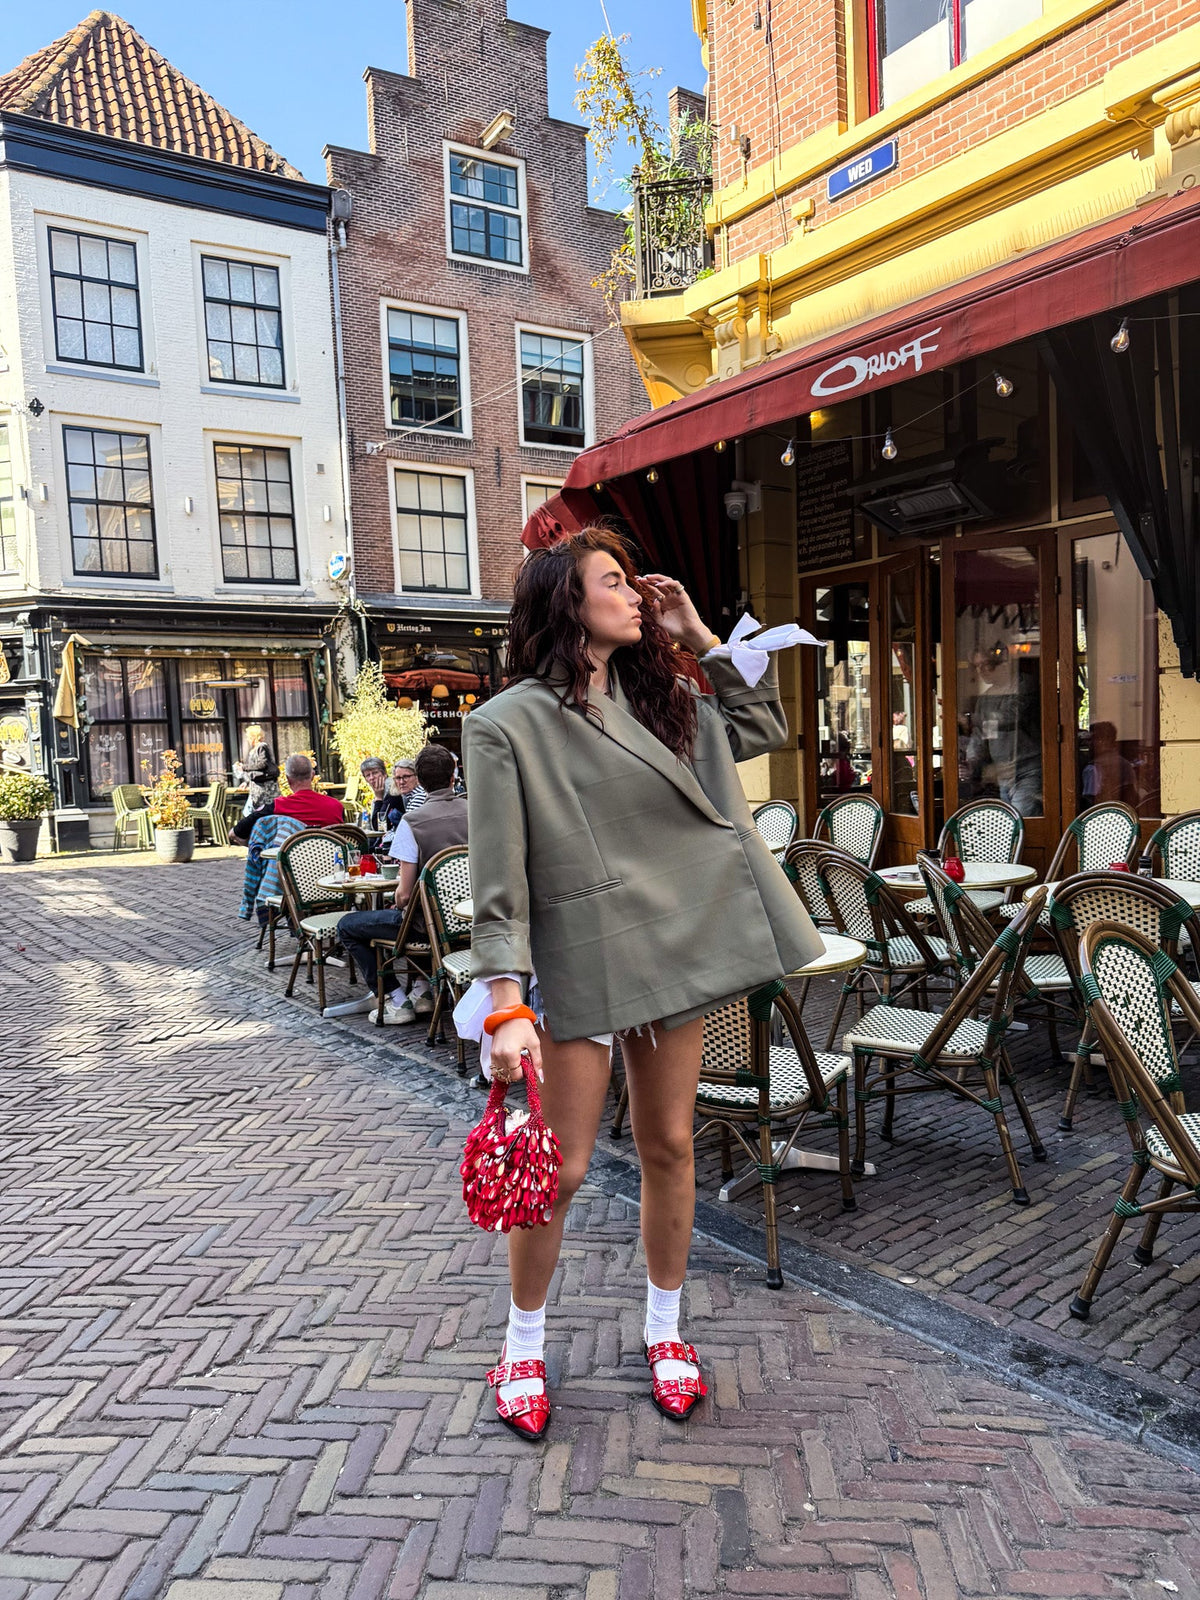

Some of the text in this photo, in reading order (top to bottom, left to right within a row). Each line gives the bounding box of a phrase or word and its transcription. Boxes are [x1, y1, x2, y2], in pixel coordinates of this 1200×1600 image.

[848, 157, 873, 184] WED
[396, 623, 431, 632] Hertog Jan
[190, 698, 215, 711] HW
[186, 742, 224, 753] LUNCH
